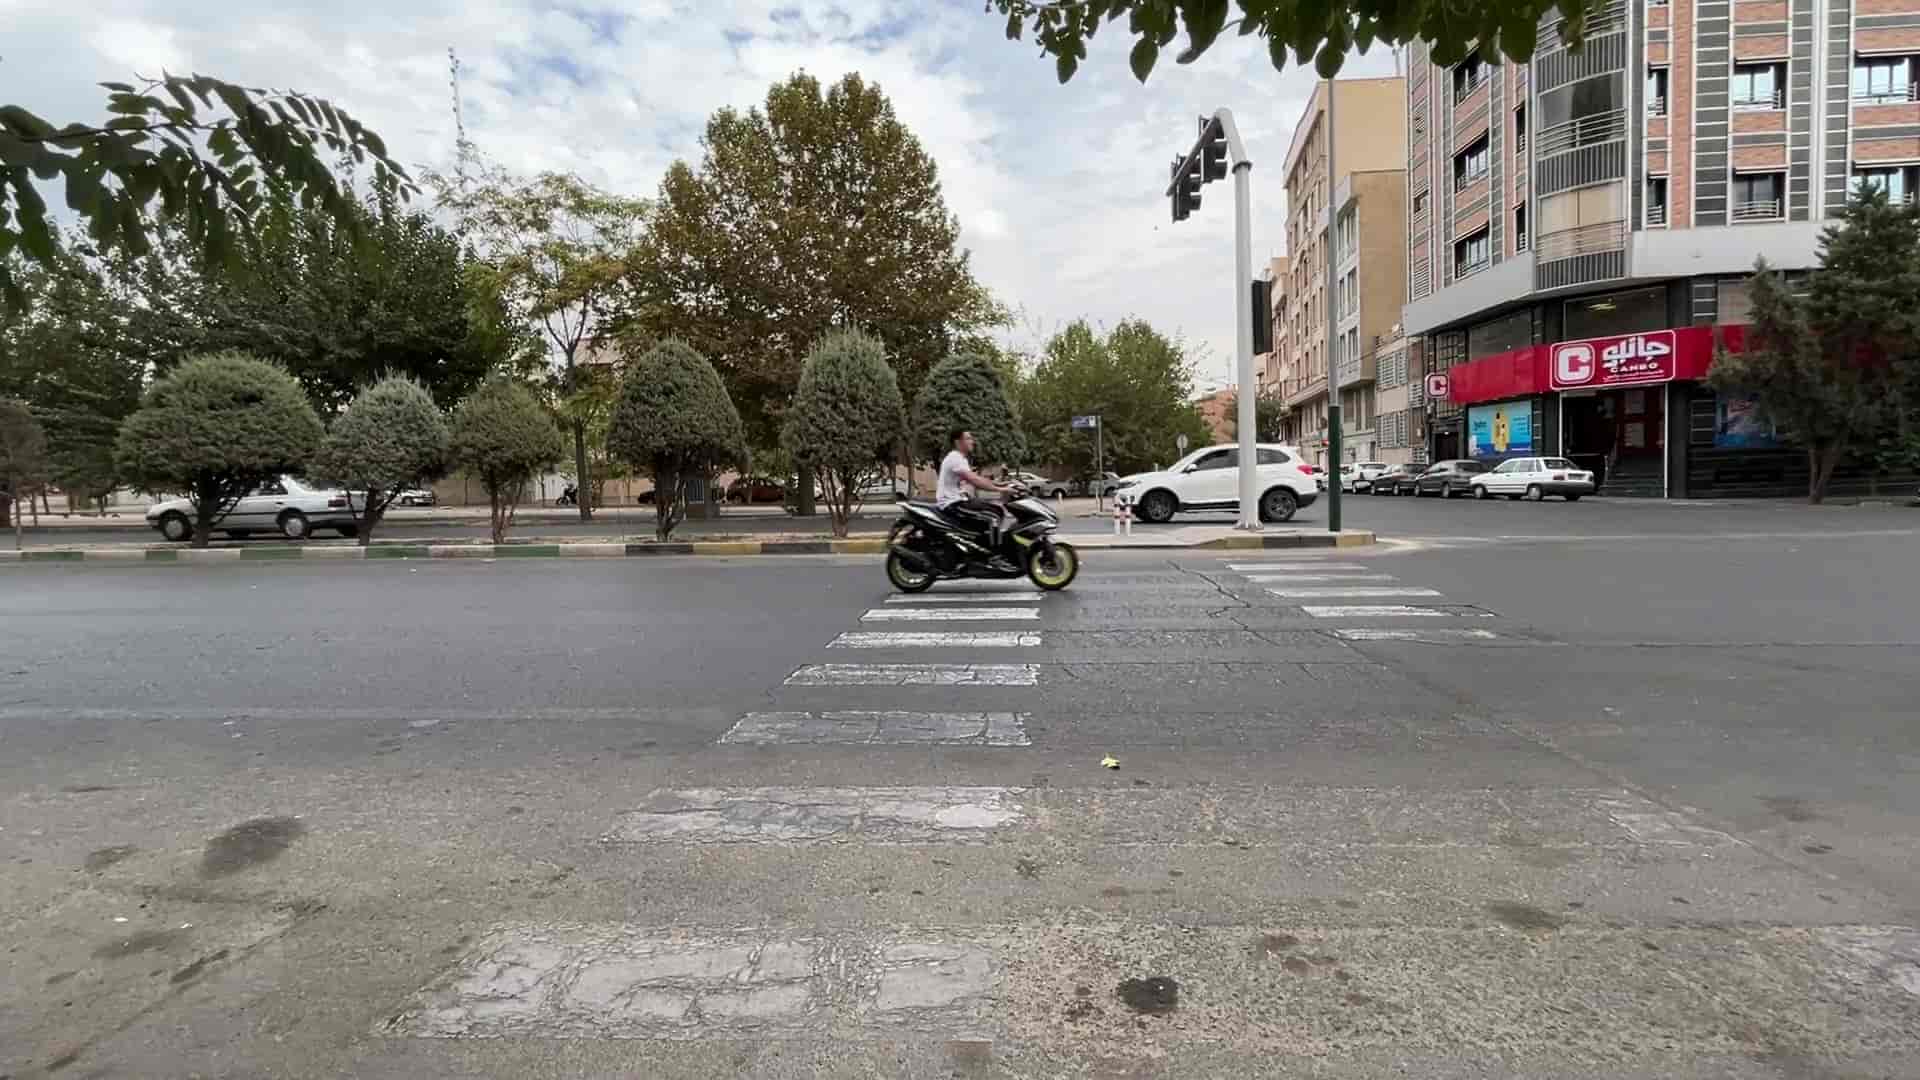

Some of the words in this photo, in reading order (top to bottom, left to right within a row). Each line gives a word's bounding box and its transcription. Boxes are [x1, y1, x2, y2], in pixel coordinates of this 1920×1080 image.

[1558, 346, 1591, 381] C
[1602, 336, 1670, 369] جانبو
[1609, 361, 1658, 373] CANBO
[1429, 375, 1447, 396] C
